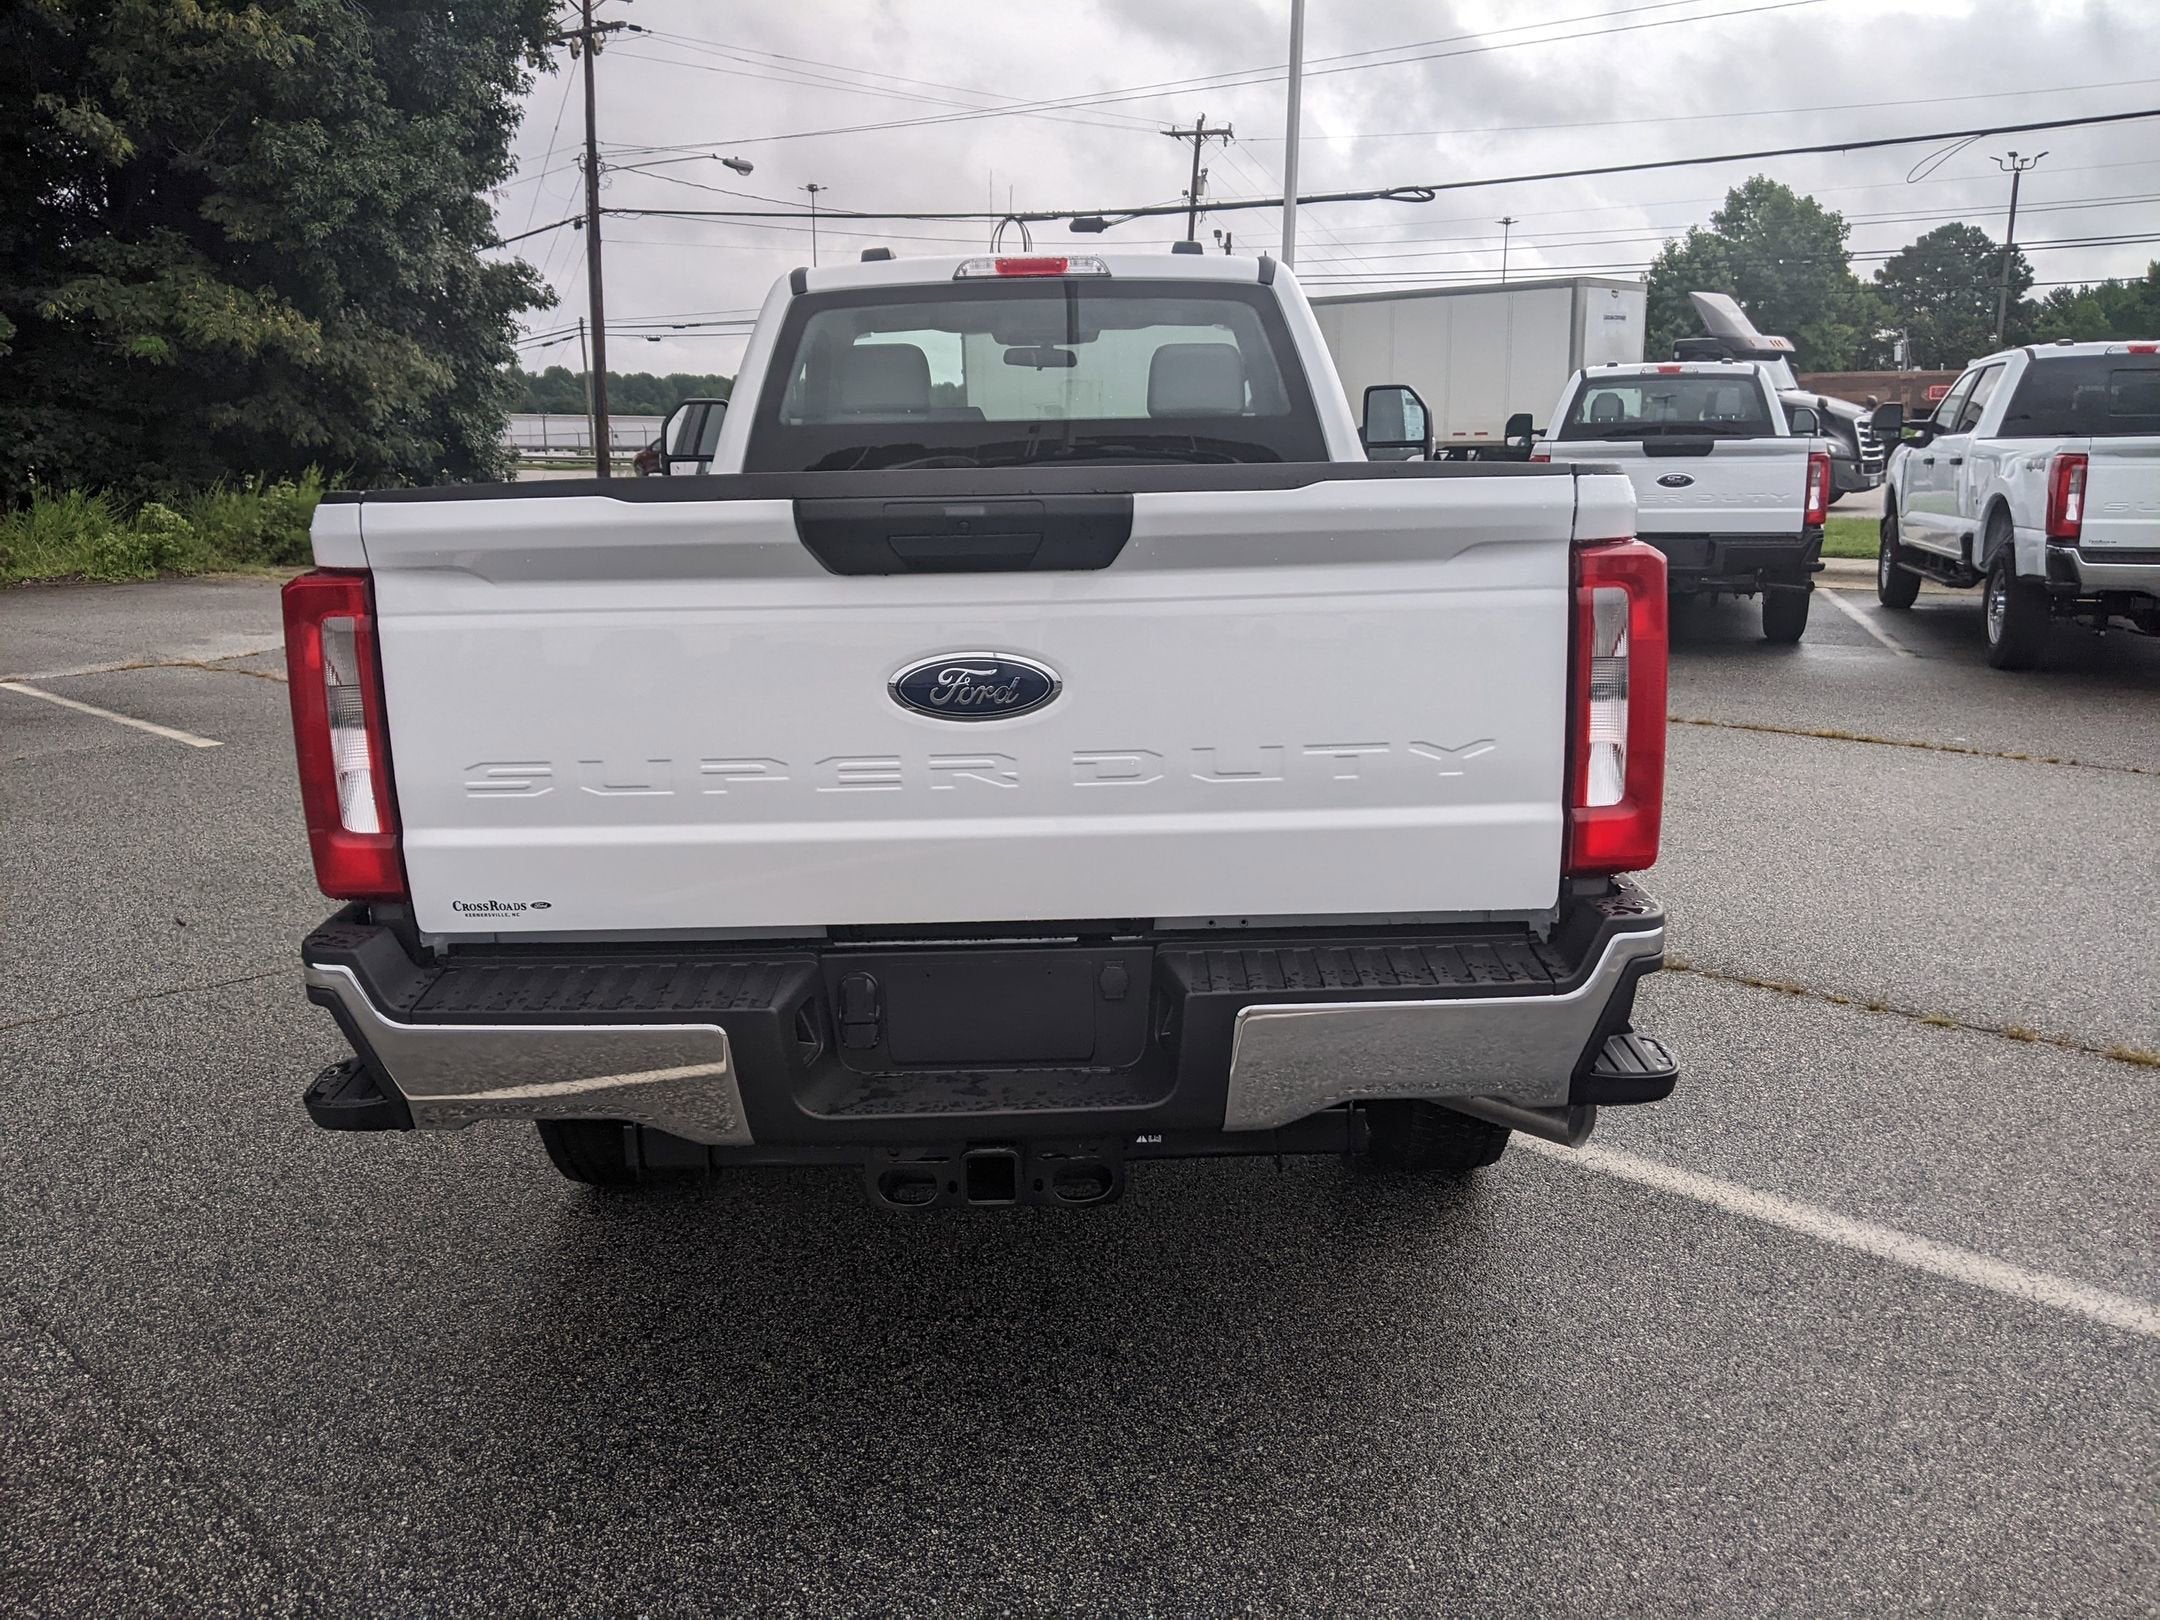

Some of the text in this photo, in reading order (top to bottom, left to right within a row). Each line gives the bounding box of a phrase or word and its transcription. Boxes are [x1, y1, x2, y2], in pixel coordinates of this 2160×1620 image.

[1696, 492, 1791, 503] DUTY
[929, 667, 1021, 705] Ford
[463, 738, 1496, 798] SUPER DUTY
